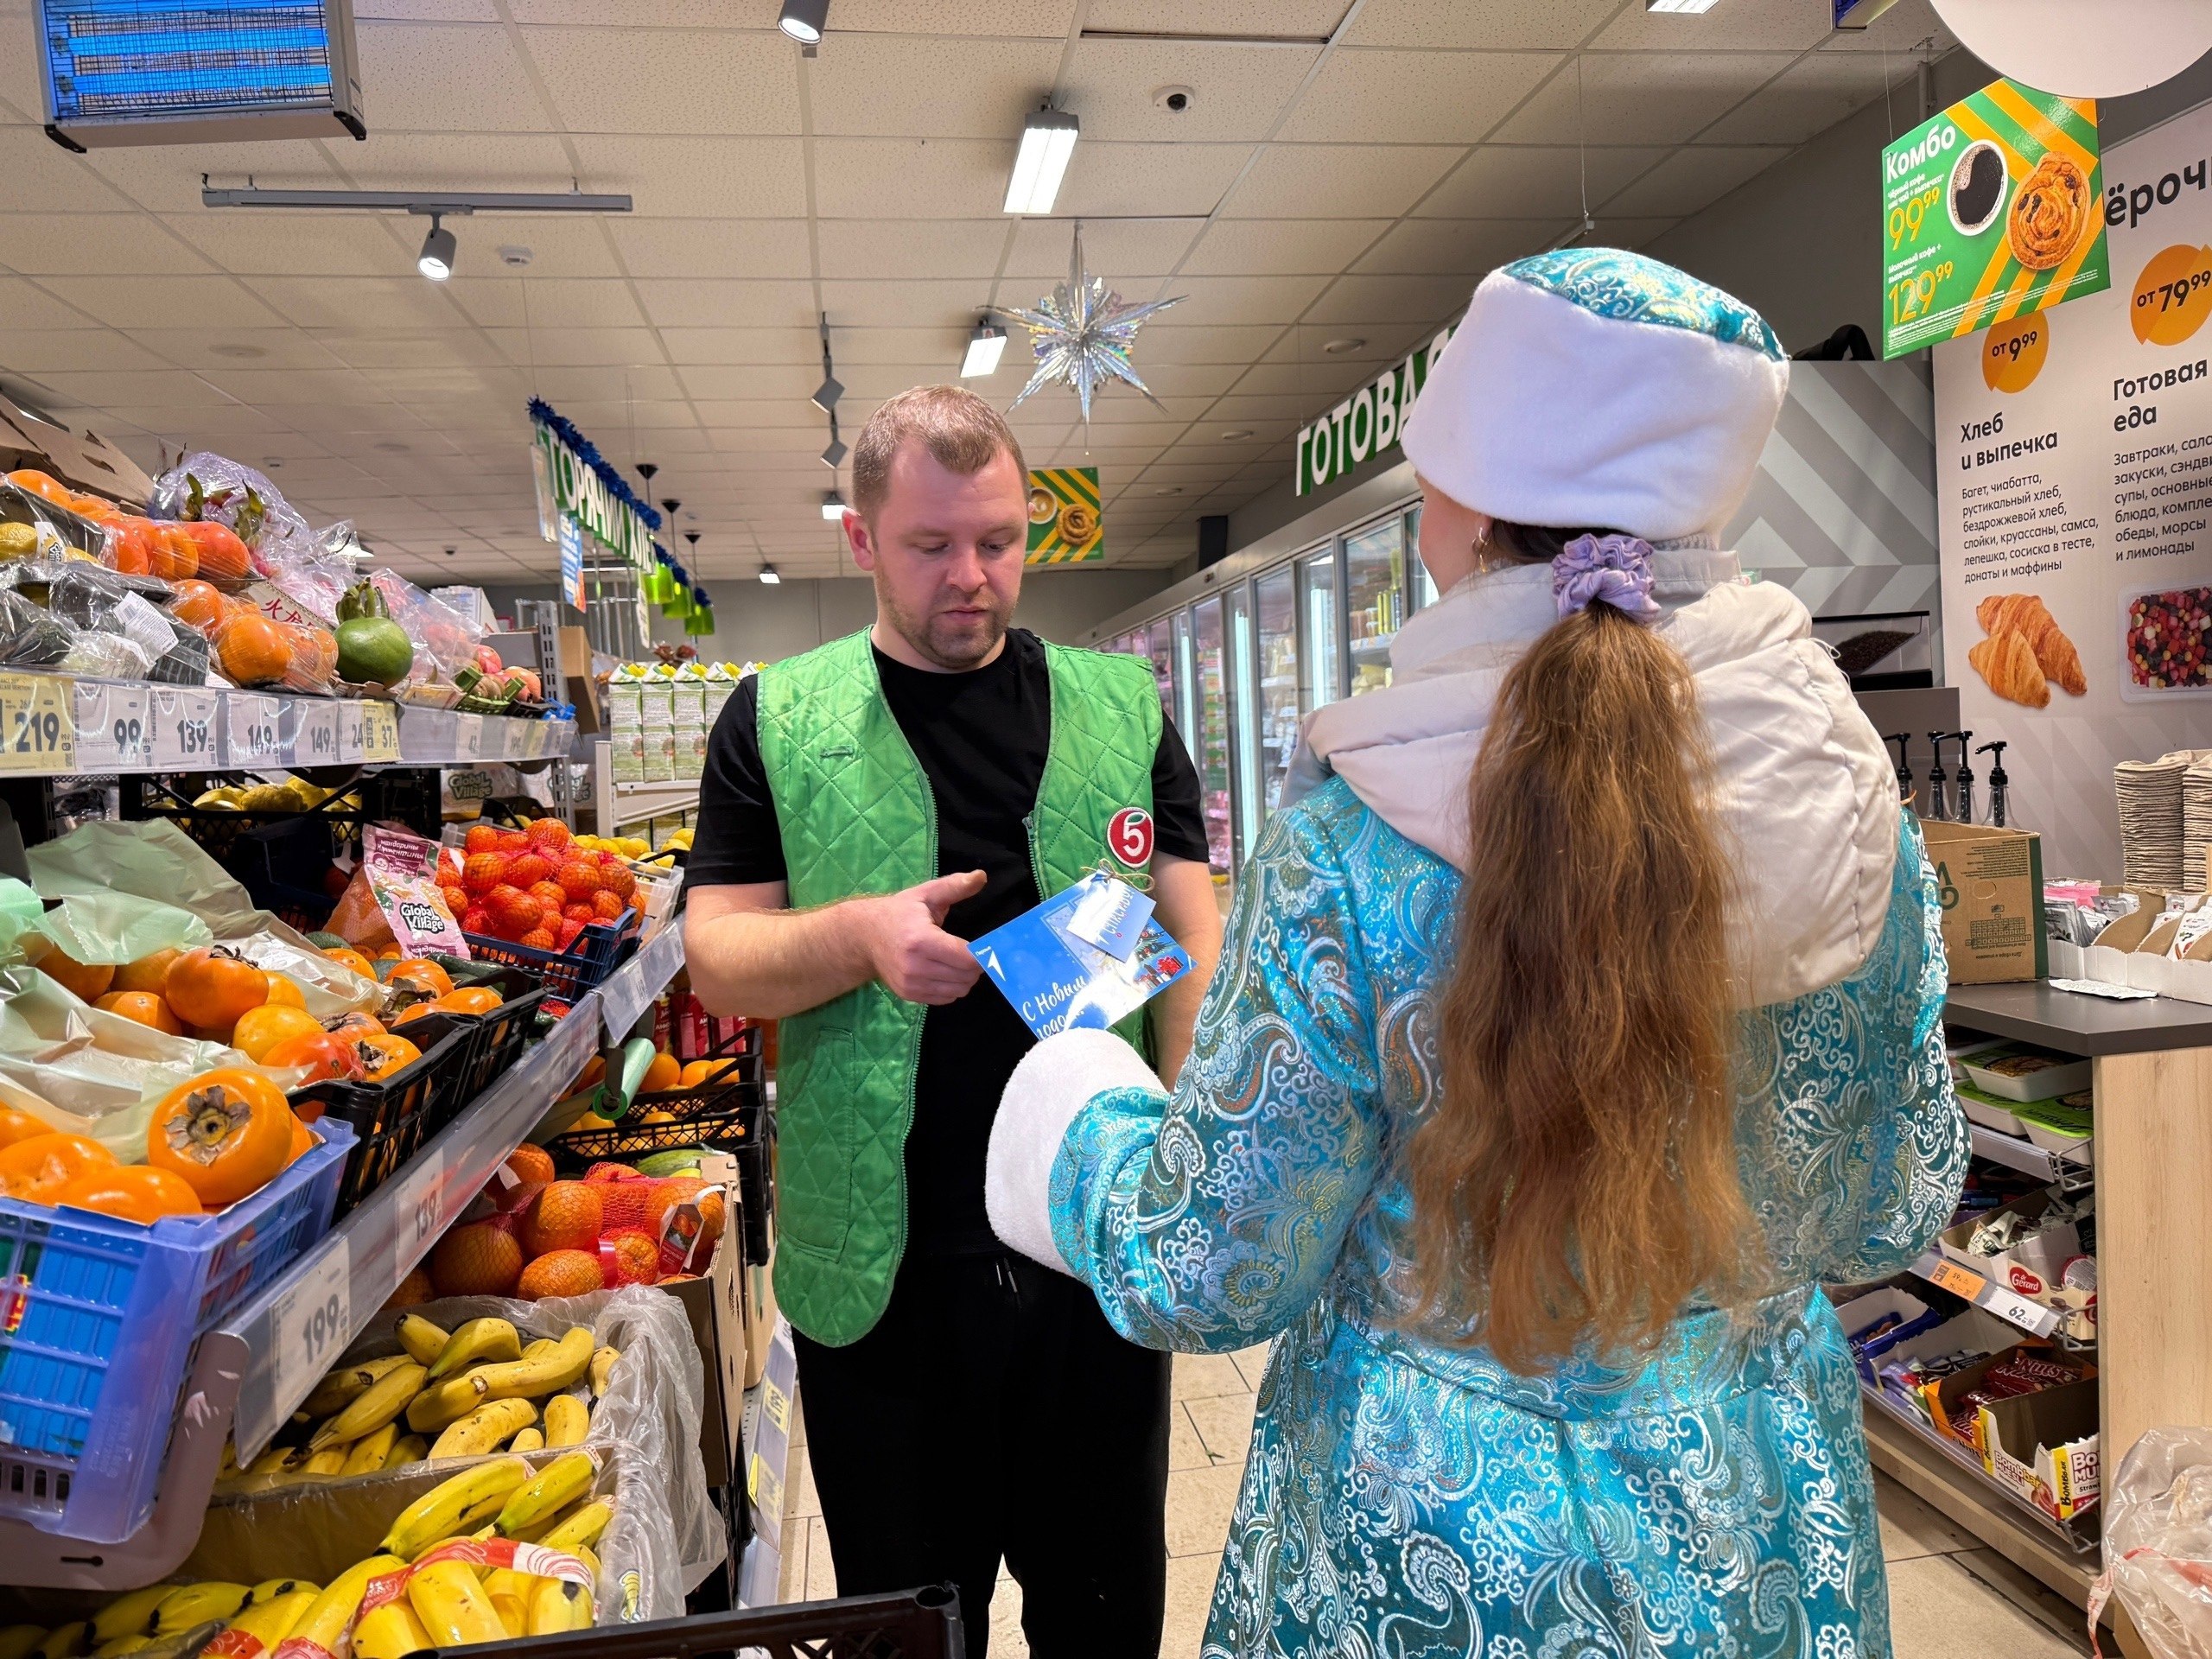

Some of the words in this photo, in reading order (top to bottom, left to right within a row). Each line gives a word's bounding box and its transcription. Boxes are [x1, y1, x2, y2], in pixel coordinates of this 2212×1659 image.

[1886, 124, 1955, 183] Комбо
[2106, 156, 2212, 229] ёроч
[2137, 290, 2156, 308] от
[1992, 343, 2006, 357] от
[2113, 359, 2208, 401] Готовая
[1961, 411, 2004, 443] Хлеб
[2113, 405, 2157, 432] еда
[1961, 454, 1971, 470] и
[1976, 432, 2057, 467] выпечка
[2113, 444, 2178, 466] Завтраки,
[1962, 486, 1989, 499] Багет,
[1991, 474, 2042, 493] чиабатта,
[2114, 466, 2167, 485] закуски,
[1962, 492, 2031, 518] рустикальный
[2033, 485, 2062, 502] хлеб,
[2114, 489, 2148, 506] супы,
[1963, 509, 2037, 532] бездрожжевой
[2038, 502, 2067, 518] хлеб,
[2115, 507, 2159, 524] блюда,
[1964, 536, 1999, 550] слойки,
[2000, 525, 2058, 545] круассаны,
[2061, 518, 2099, 532] самса,
[2115, 527, 2158, 543] обеды,
[2162, 518, 2207, 536] морсы
[1964, 551, 2007, 566] лепешка,
[2009, 543, 2050, 559] сосиска
[2053, 543, 2059, 552] в
[2062, 537, 2095, 551] тесте,
[2115, 551, 2123, 562] и
[2126, 541, 2195, 560] лимонады
[1964, 569, 2000, 585] донаты
[2002, 567, 2008, 577] и
[2011, 560, 2062, 577] маффины
[261, 598, 316, 628] 火龙
[15, 711, 60, 752] 219
[114, 718, 142, 753] 99
[176, 719, 207, 753] 139
[310, 725, 331, 753] 149
[1122, 812, 1146, 857] 5
[400, 903, 439, 920] Global
[406, 915, 445, 933] Village
[1022, 1001, 1036, 1022] С
[2012, 1273, 2039, 1292] Gerard
[2008, 1306, 2026, 1321] 62
[302, 1294, 340, 1365] 199
